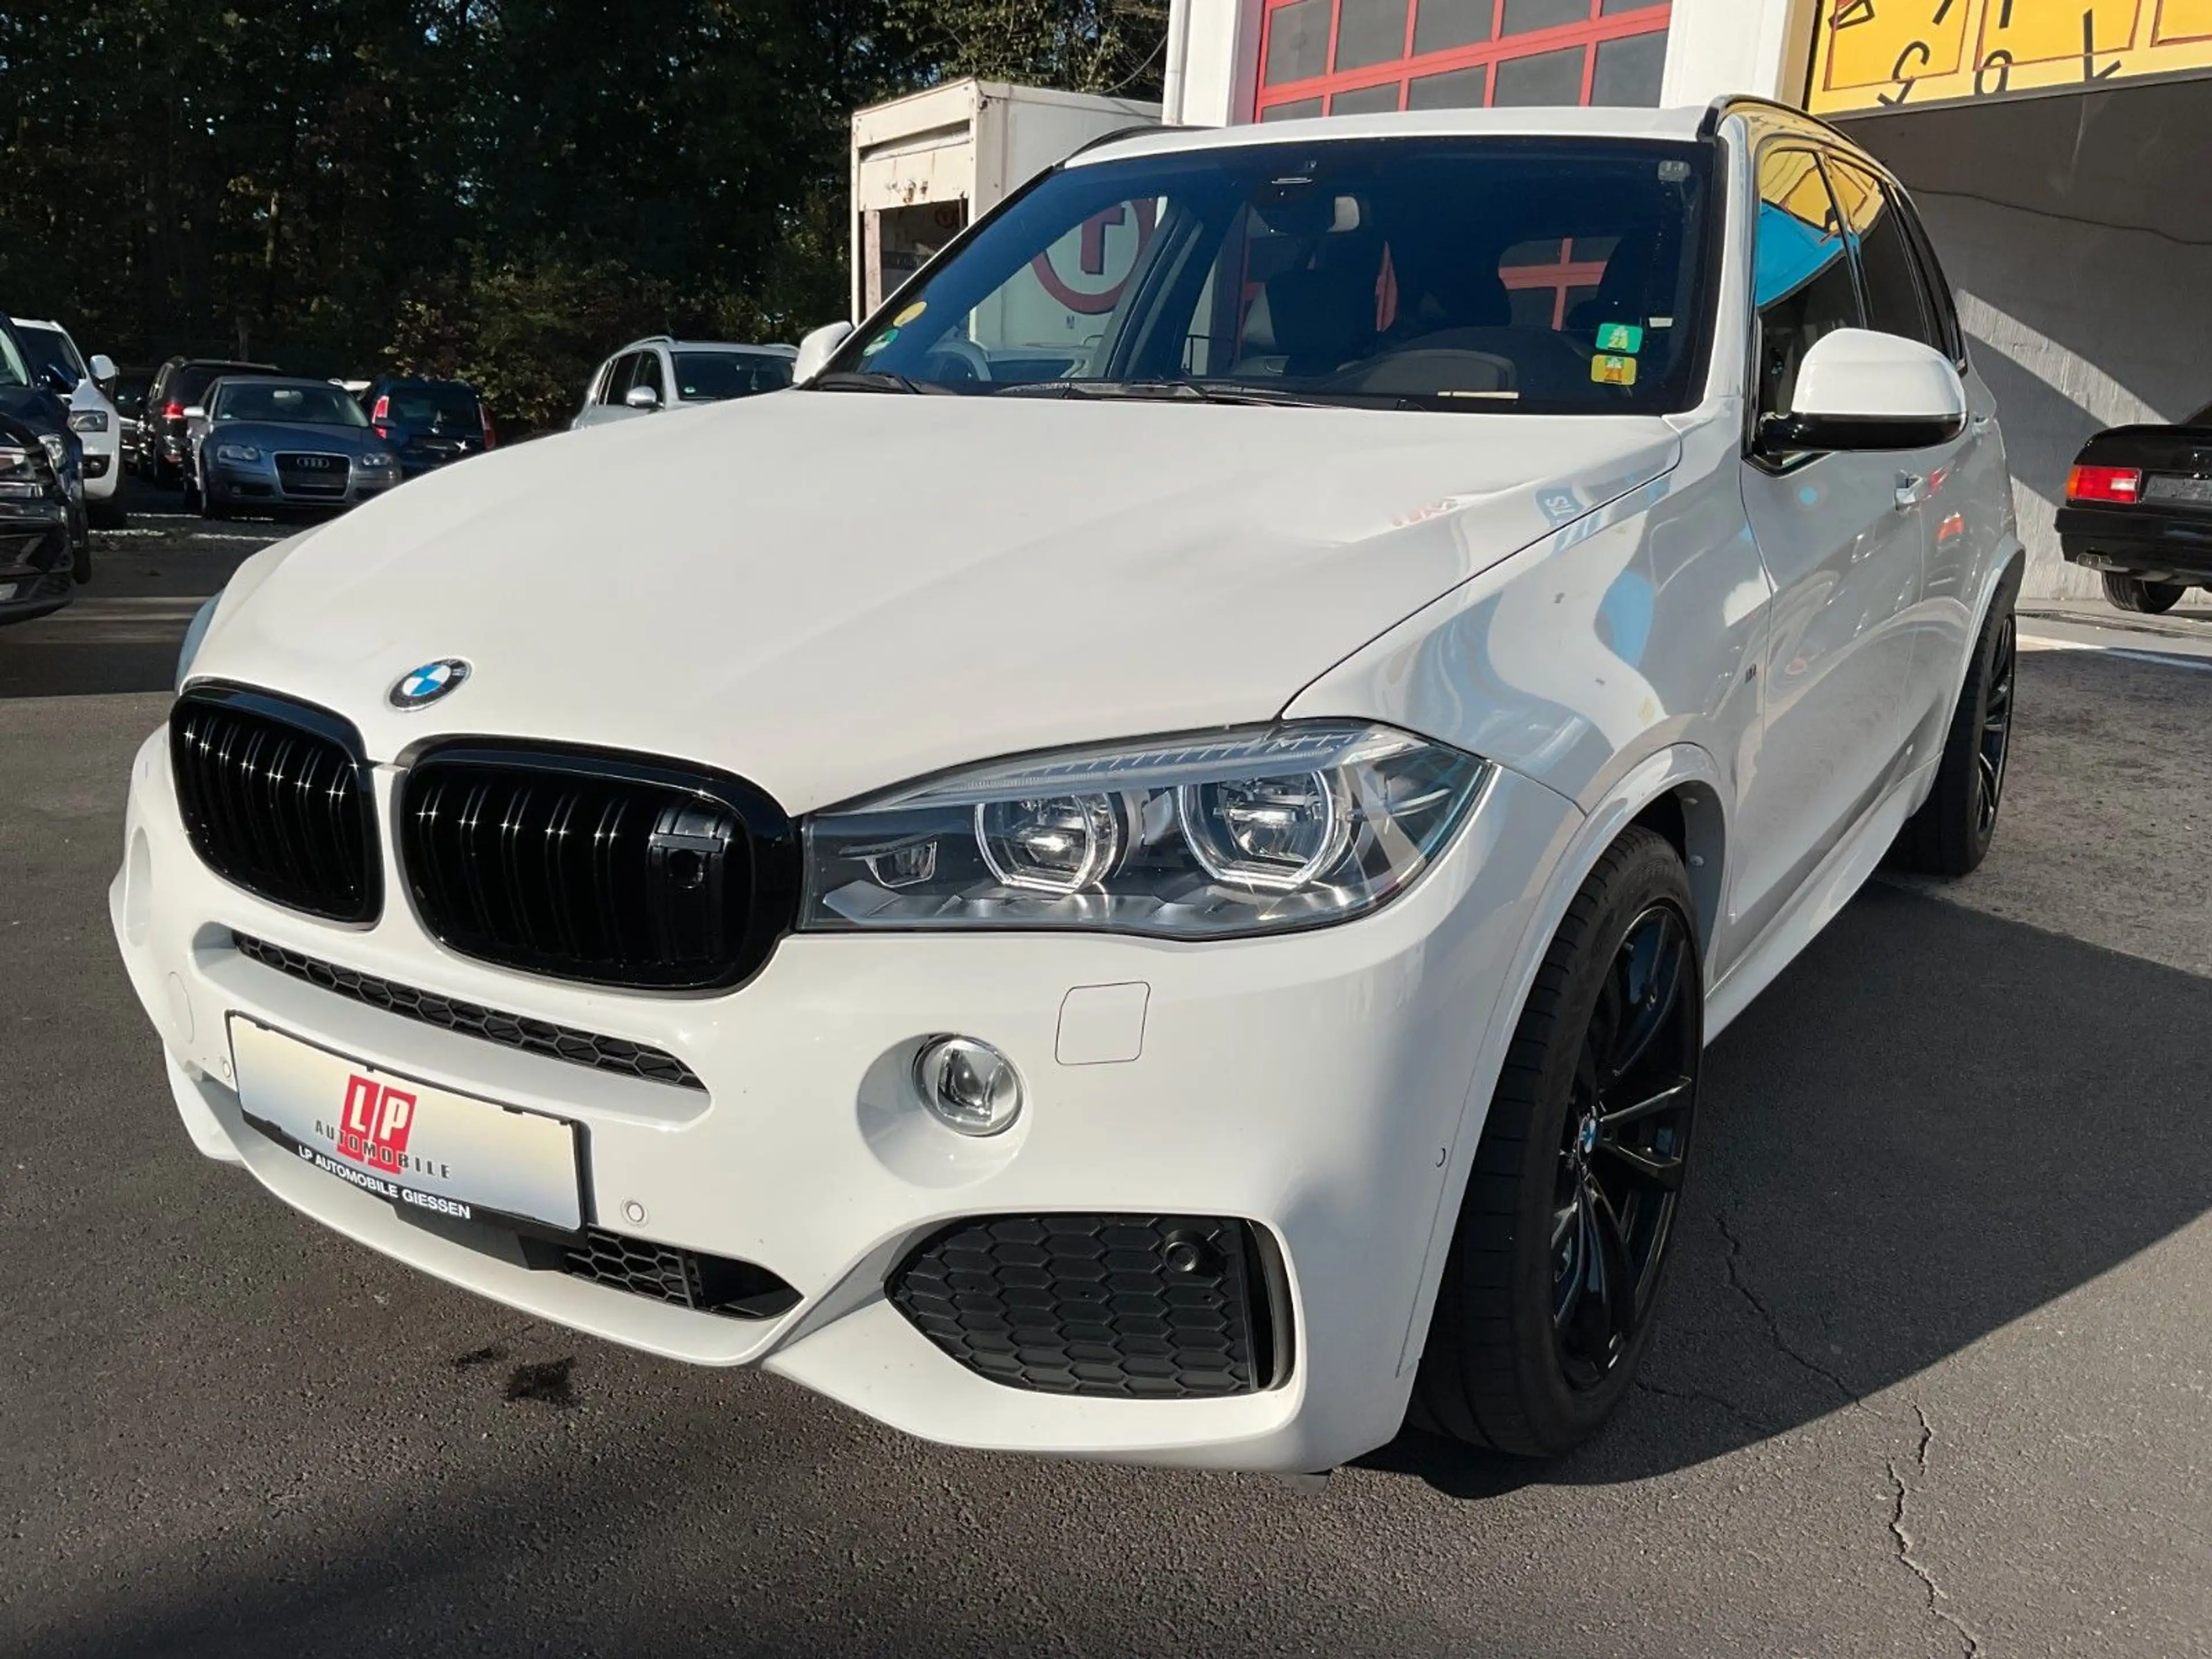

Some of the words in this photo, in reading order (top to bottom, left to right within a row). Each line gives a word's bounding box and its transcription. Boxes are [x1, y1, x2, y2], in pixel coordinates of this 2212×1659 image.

[350, 1085, 410, 1141] LP
[315, 1120, 451, 1179] AUTOMOBILE
[298, 1145, 312, 1160] LP
[315, 1156, 399, 1198] AUTOMOBILE
[402, 1189, 471, 1219] GIESSEN
